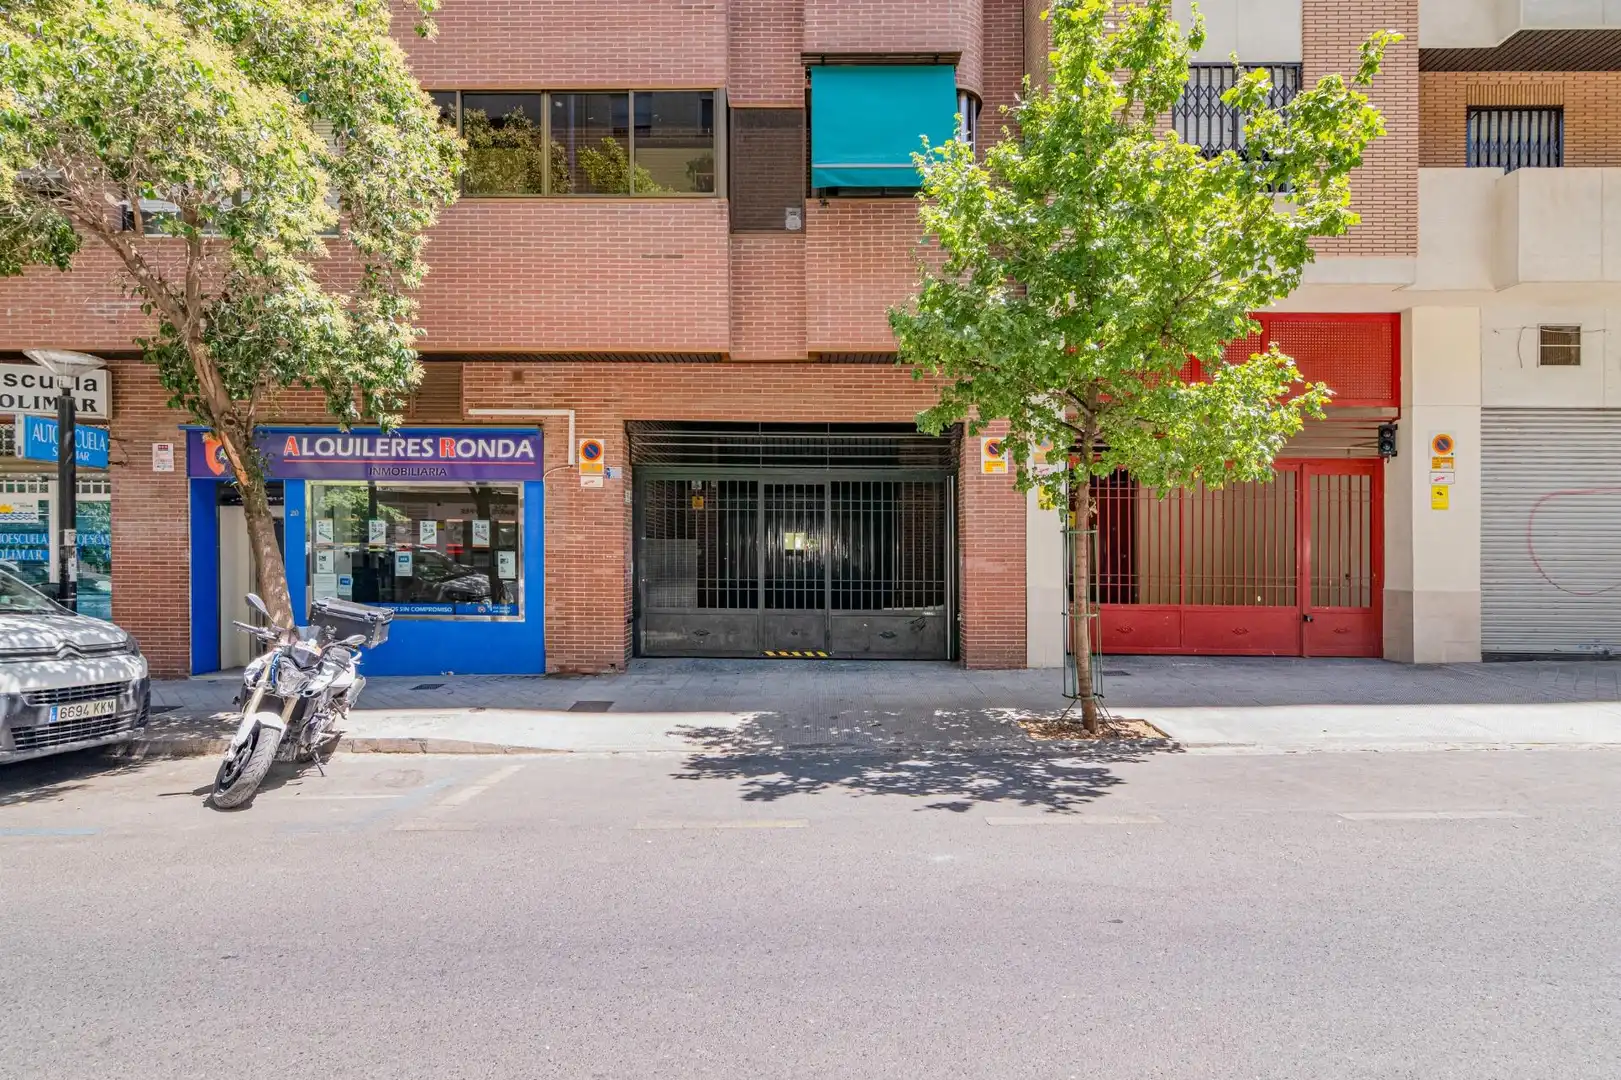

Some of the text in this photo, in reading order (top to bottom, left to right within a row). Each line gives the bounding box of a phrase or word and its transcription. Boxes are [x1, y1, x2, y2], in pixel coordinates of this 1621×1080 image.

[3, 373, 98, 391] scula
[0, 394, 97, 412] OLIMR
[284, 436, 534, 458] ALQUILERES RONDA
[369, 467, 447, 476] INMOBILIARIA
[60, 701, 114, 719] 6694 KKM
